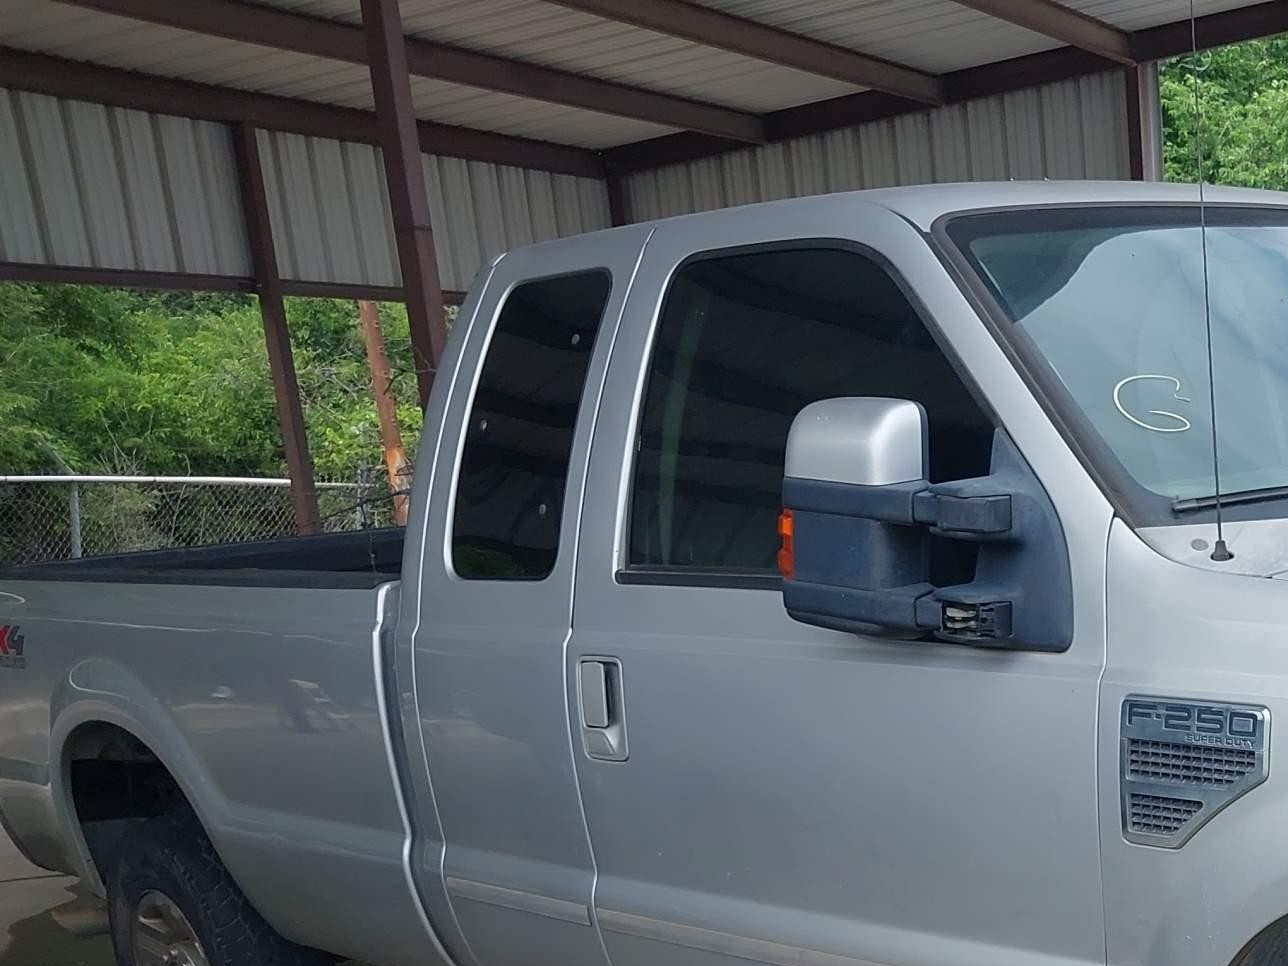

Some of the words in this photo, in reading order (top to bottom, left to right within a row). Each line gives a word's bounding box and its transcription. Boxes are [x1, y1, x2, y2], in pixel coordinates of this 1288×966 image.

[1126, 702, 1260, 738] F-250
[1184, 733, 1223, 746] SUPER
[1226, 736, 1257, 748] DUTY
